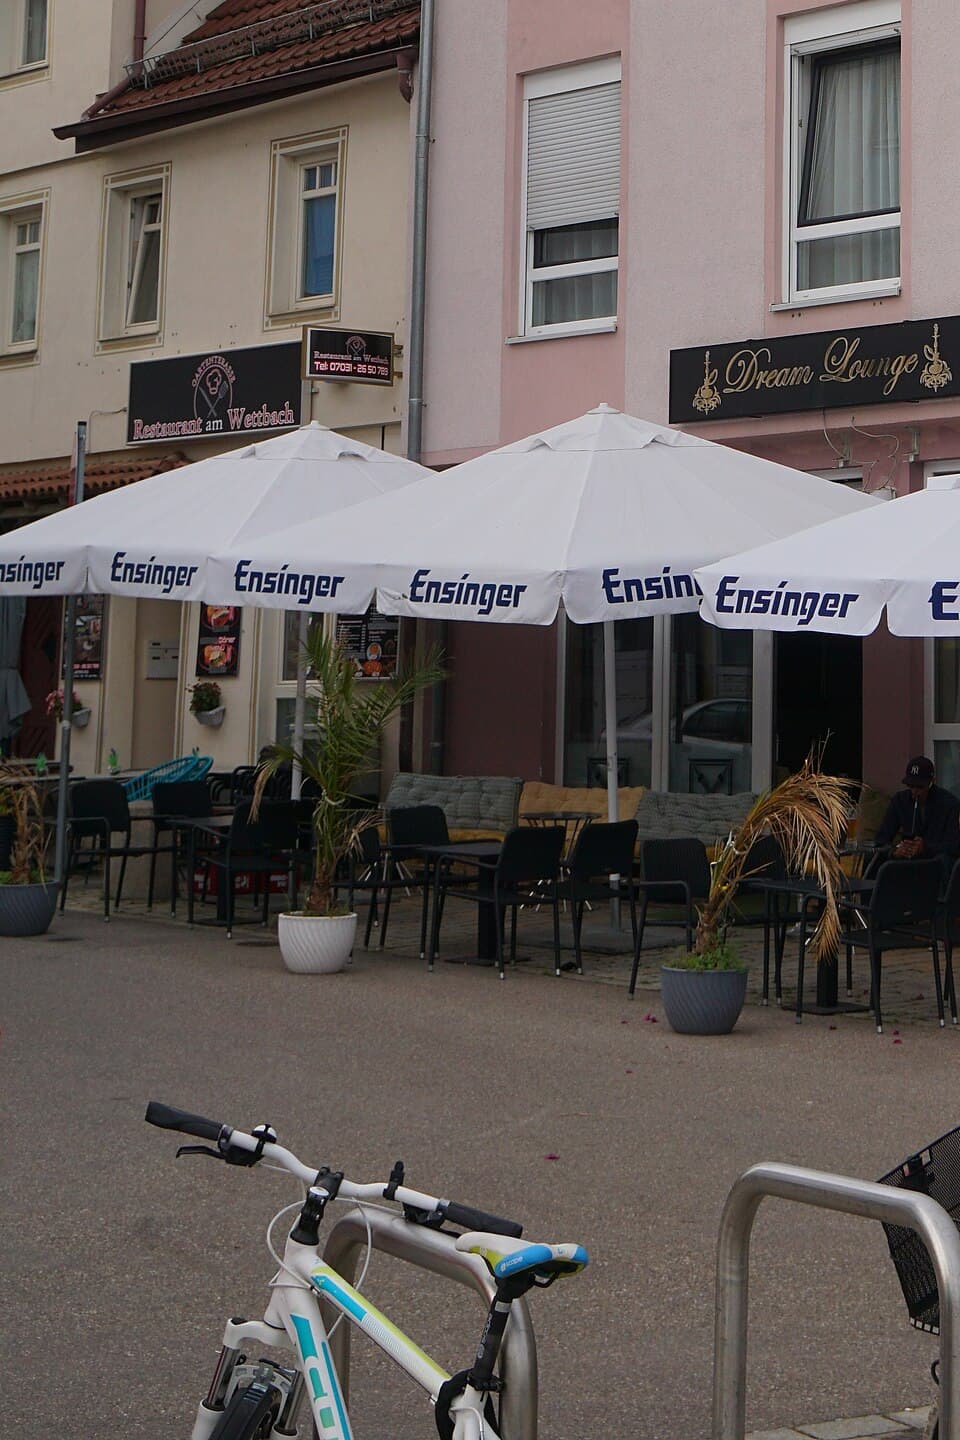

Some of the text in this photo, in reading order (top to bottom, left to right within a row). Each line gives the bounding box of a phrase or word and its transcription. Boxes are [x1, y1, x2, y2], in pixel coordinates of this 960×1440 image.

[314, 361, 329, 371] Tel:
[329, 362, 352, 372] 07031
[723, 336, 919, 396] Dream Lounge
[133, 401, 295, 440] Restaurant am Wettbach
[111, 552, 199, 594] Ensinger
[234, 560, 345, 604] Ensinger
[409, 569, 527, 615] Ensinger
[602, 566, 703, 606] Ensin
[715, 576, 859, 625] Ensinger
